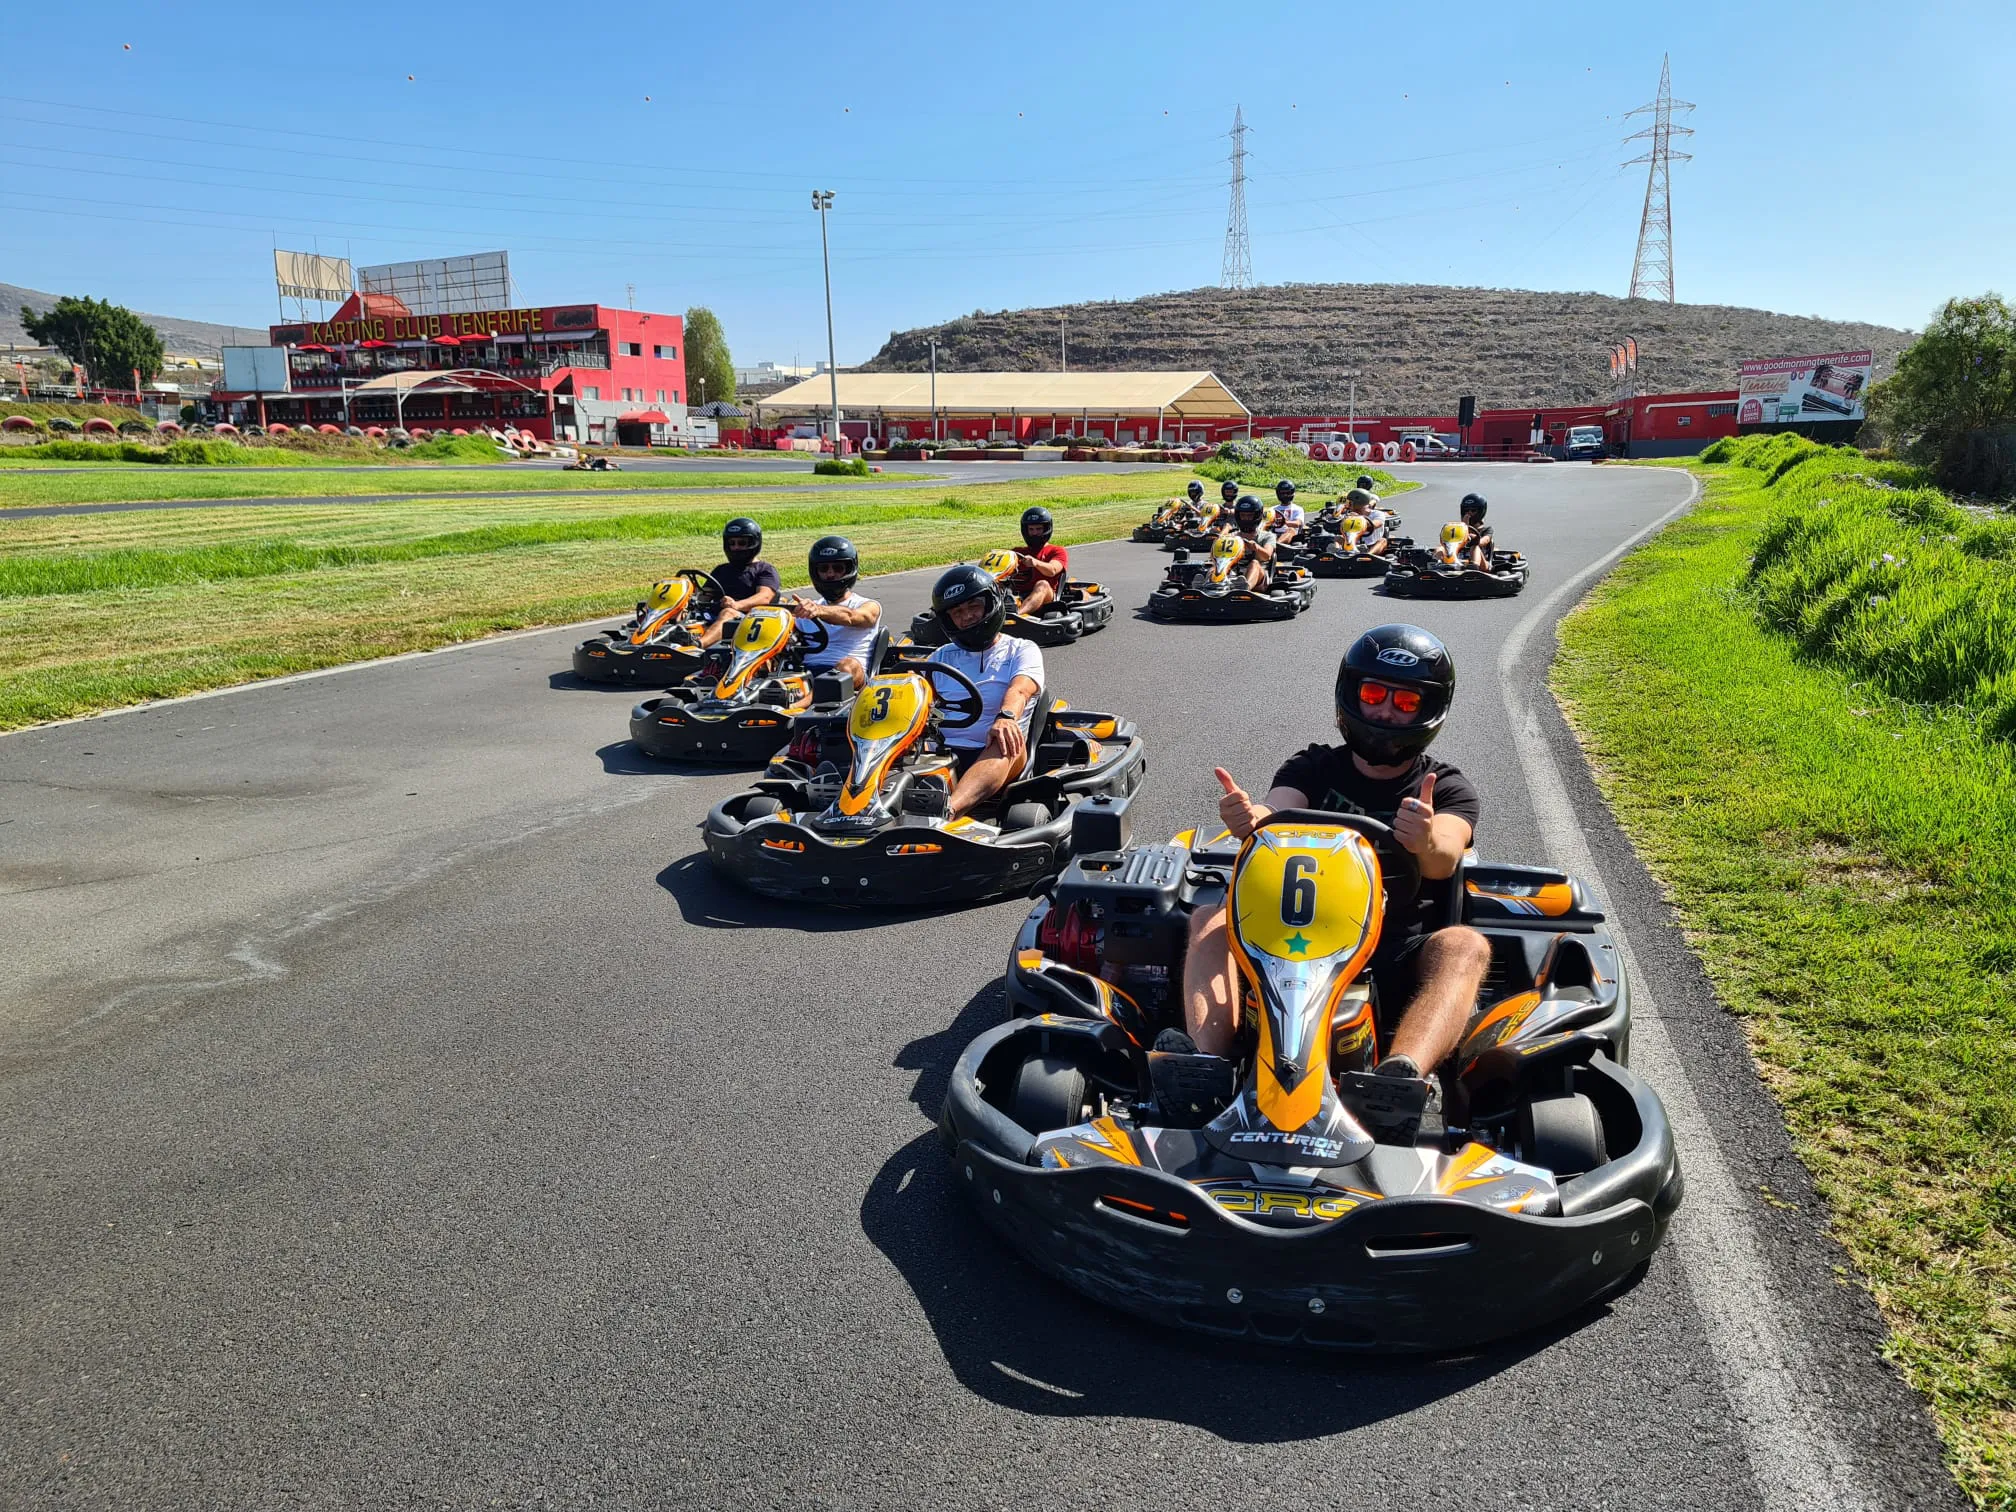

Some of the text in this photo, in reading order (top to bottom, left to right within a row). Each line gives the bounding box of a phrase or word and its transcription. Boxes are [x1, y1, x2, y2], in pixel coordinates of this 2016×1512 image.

[312, 319, 385, 343] KARTING
[394, 315, 441, 338] CLUB
[452, 308, 543, 335] TENERIFE
[1743, 353, 1870, 373] www.goodmorningtenerife.com
[1450, 527, 1456, 539] 1
[1220, 539, 1235, 553] 12
[985, 553, 1004, 567] 21
[658, 584, 672, 600] 2
[746, 618, 765, 642] 5
[870, 687, 892, 722] 3
[824, 816, 877, 825] CENTURION
[1280, 854, 1318, 928] 6
[1230, 1132, 1344, 1151] CENTURION
[1301, 1148, 1341, 1160] LINE
[1207, 1189, 1361, 1221] CRG
